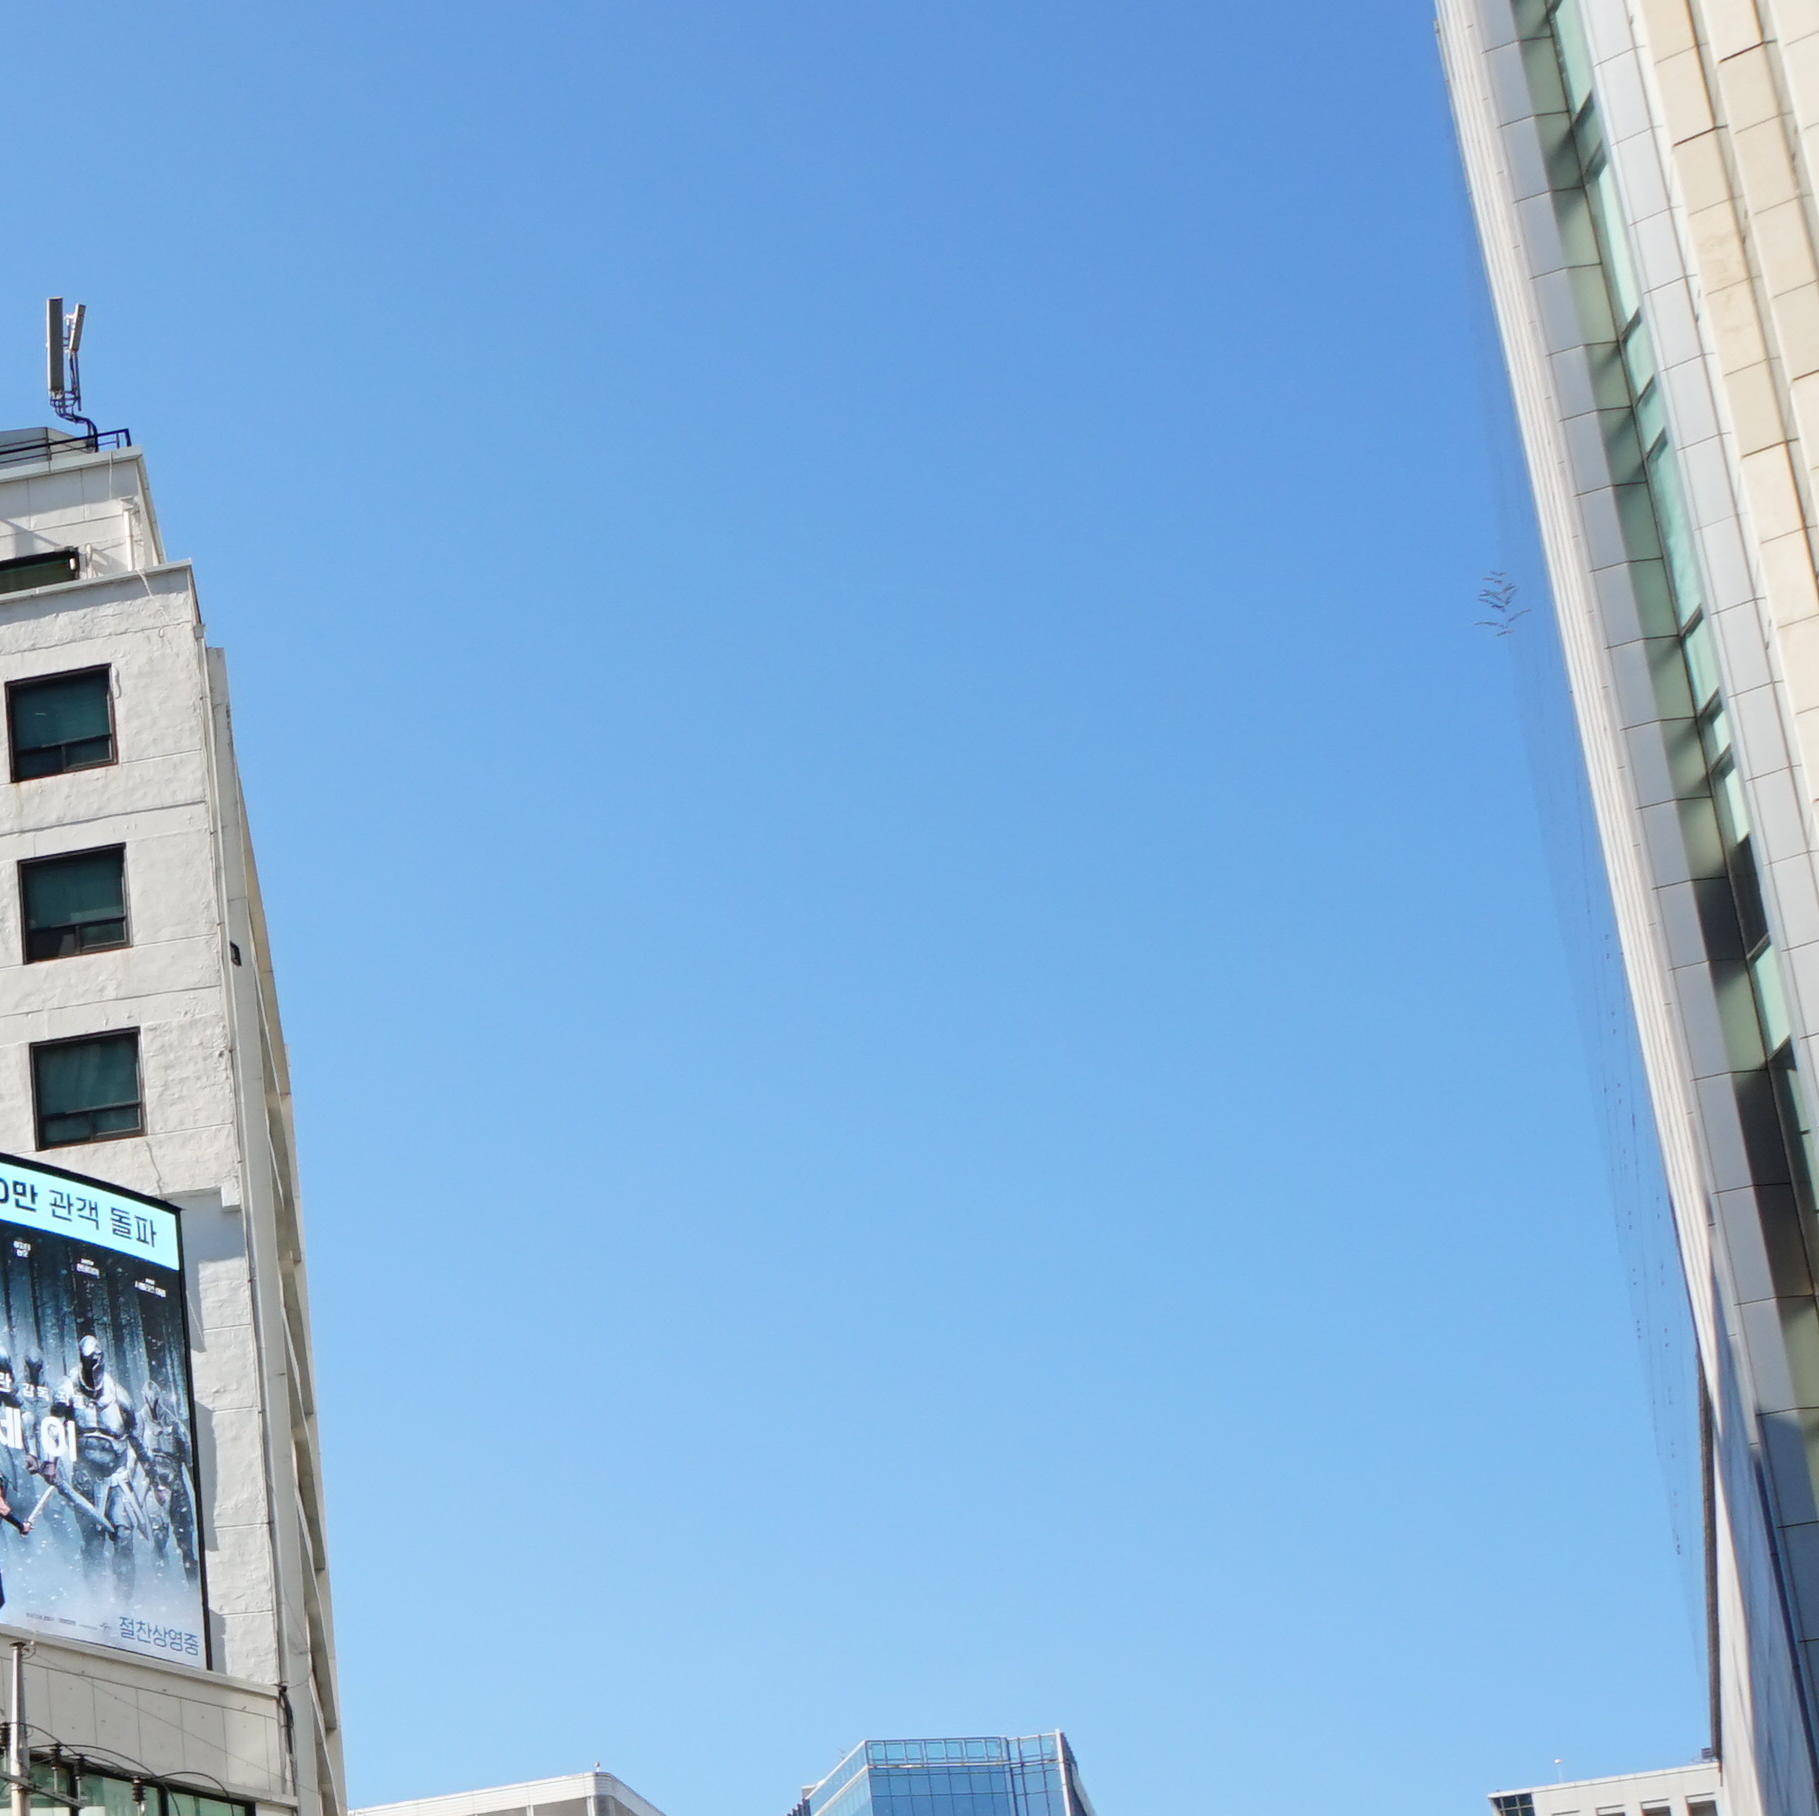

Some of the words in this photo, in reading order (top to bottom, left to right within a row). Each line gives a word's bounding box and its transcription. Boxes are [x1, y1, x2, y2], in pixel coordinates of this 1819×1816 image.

[48, 1188, 99, 1231] 관객
[110, 1205, 157, 1248] 돌파
[119, 1616, 199, 1657] 절찬상영중
